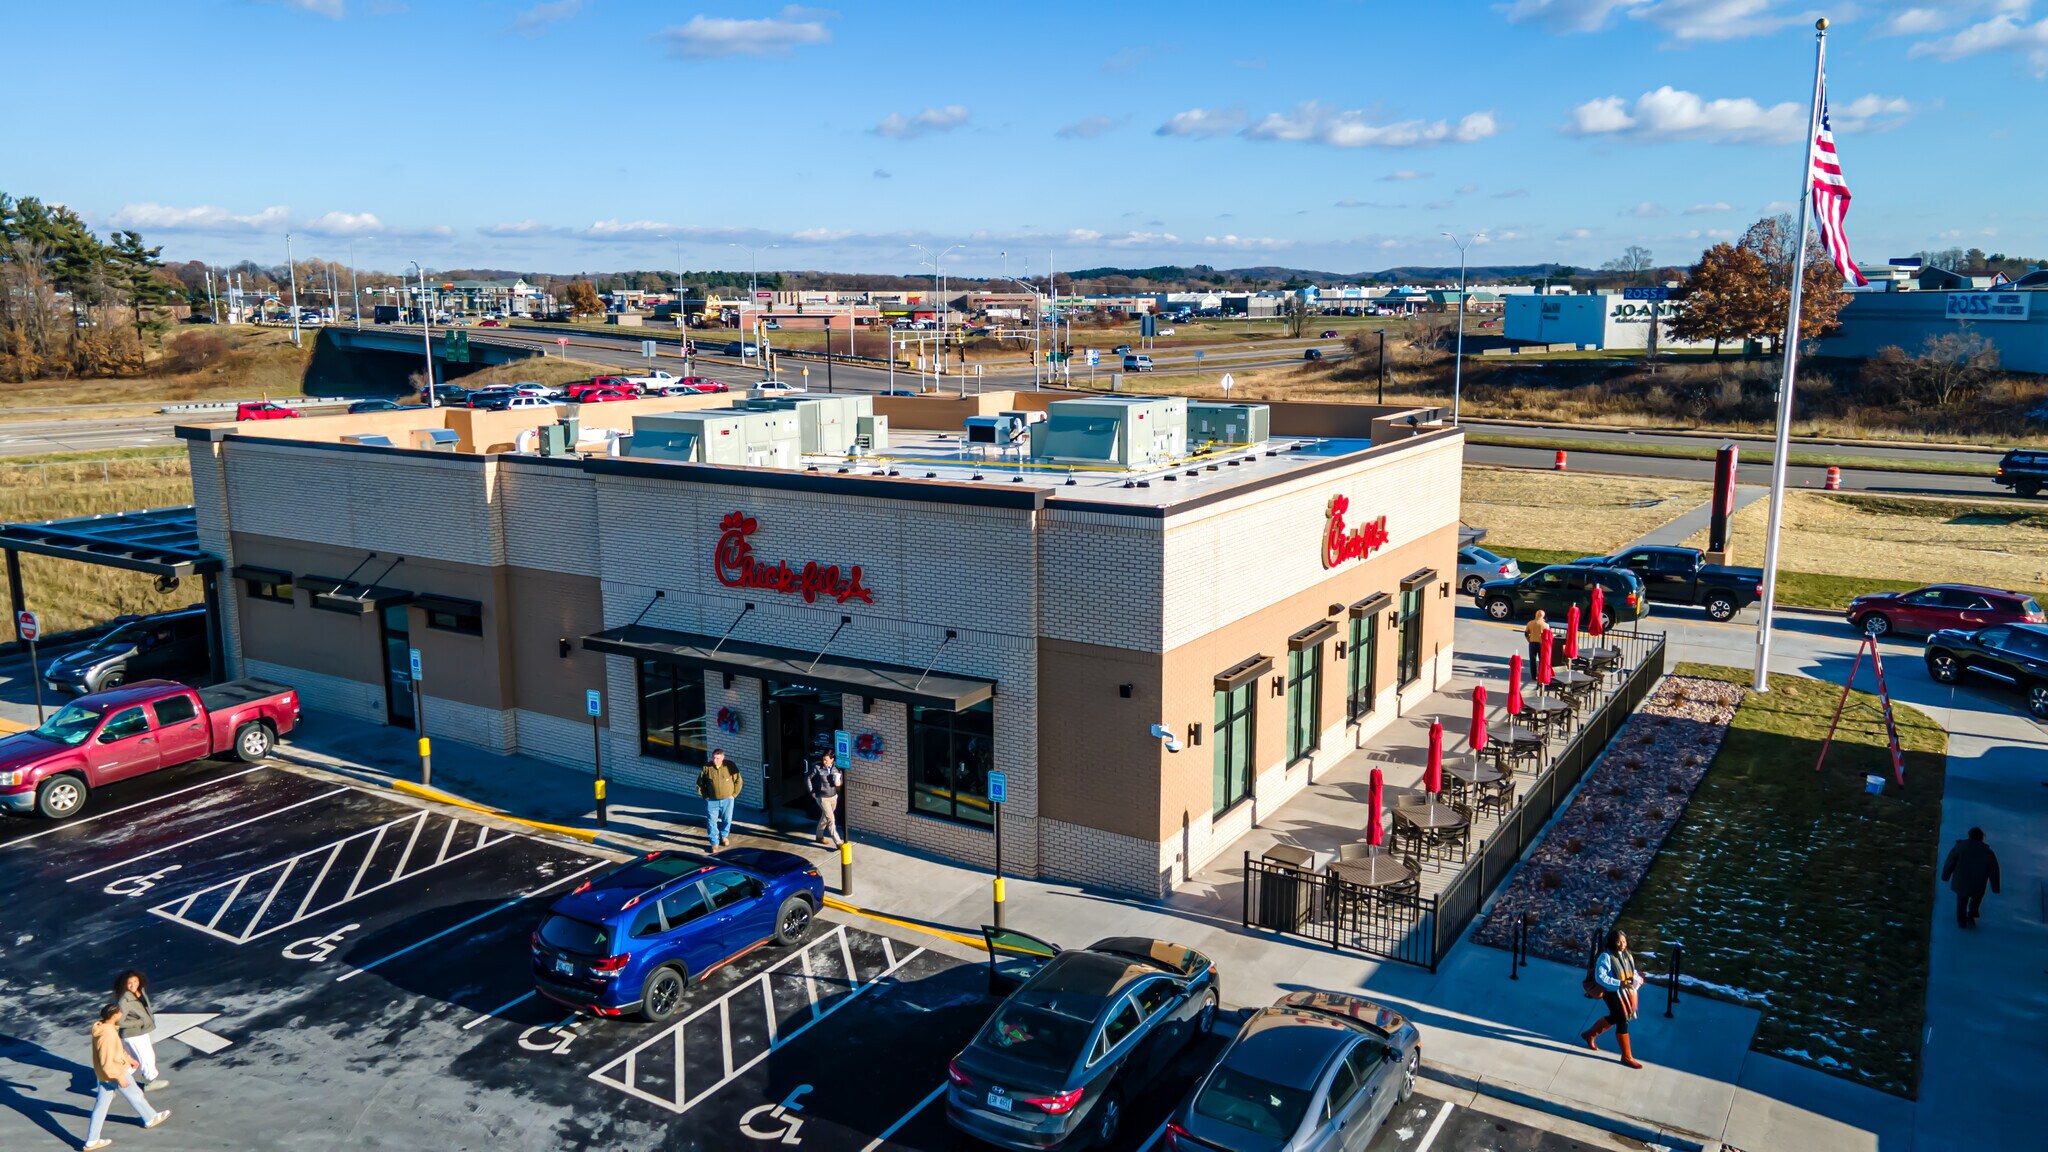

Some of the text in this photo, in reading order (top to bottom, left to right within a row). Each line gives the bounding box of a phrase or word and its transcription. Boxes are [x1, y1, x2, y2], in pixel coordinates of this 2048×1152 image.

[1625, 288, 1659, 299] ROSS
[1948, 294, 1992, 315] ROSS
[1327, 494, 1389, 568] Chick-fil-A
[714, 510, 874, 605] Chick-fil-A
